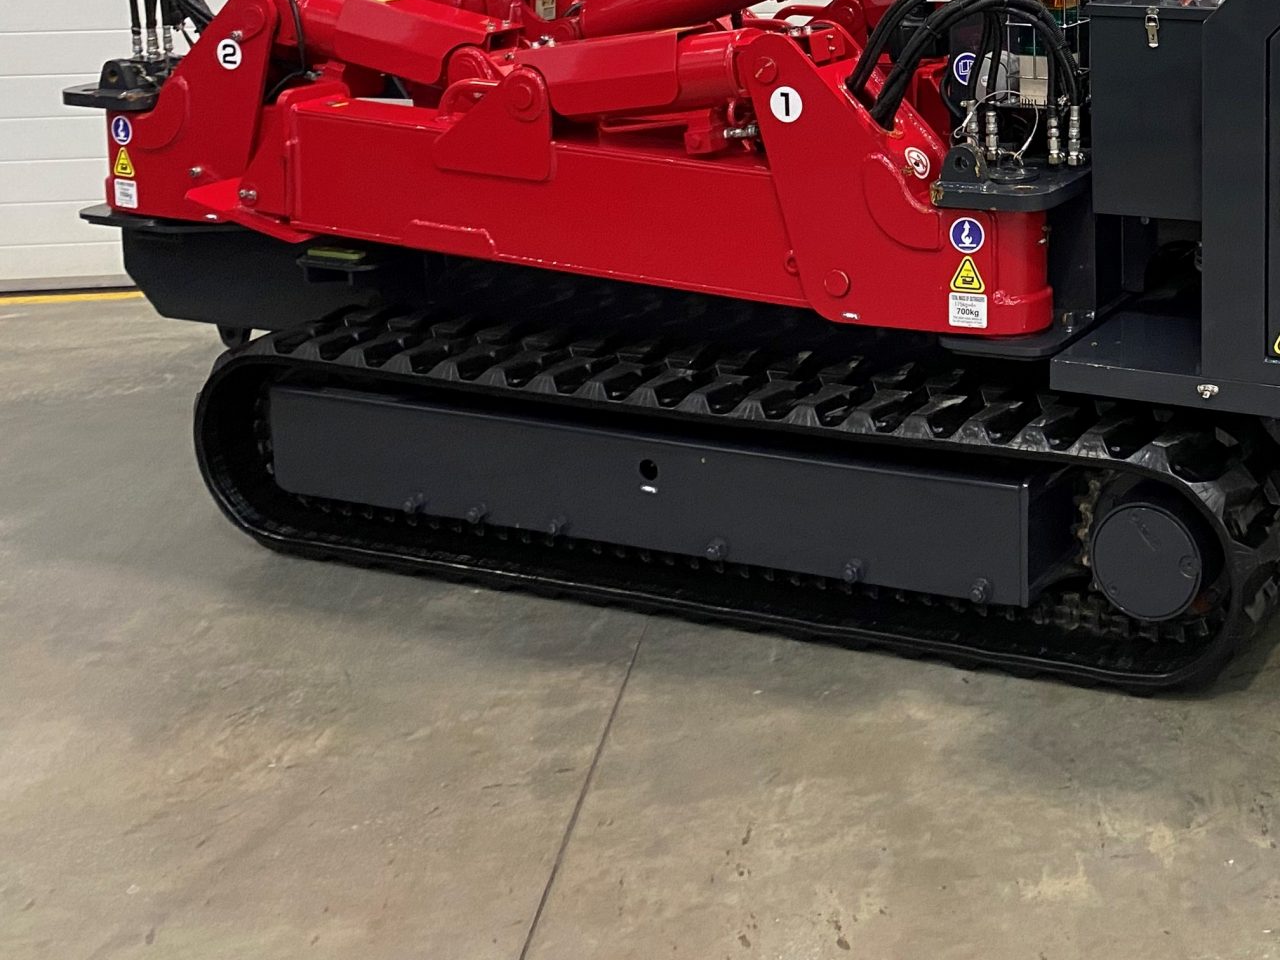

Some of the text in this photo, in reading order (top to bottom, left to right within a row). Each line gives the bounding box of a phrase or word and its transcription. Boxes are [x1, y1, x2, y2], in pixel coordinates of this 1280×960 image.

[222, 44, 237, 64] 2
[780, 92, 790, 116] 1
[957, 308, 979, 317] 700kg
